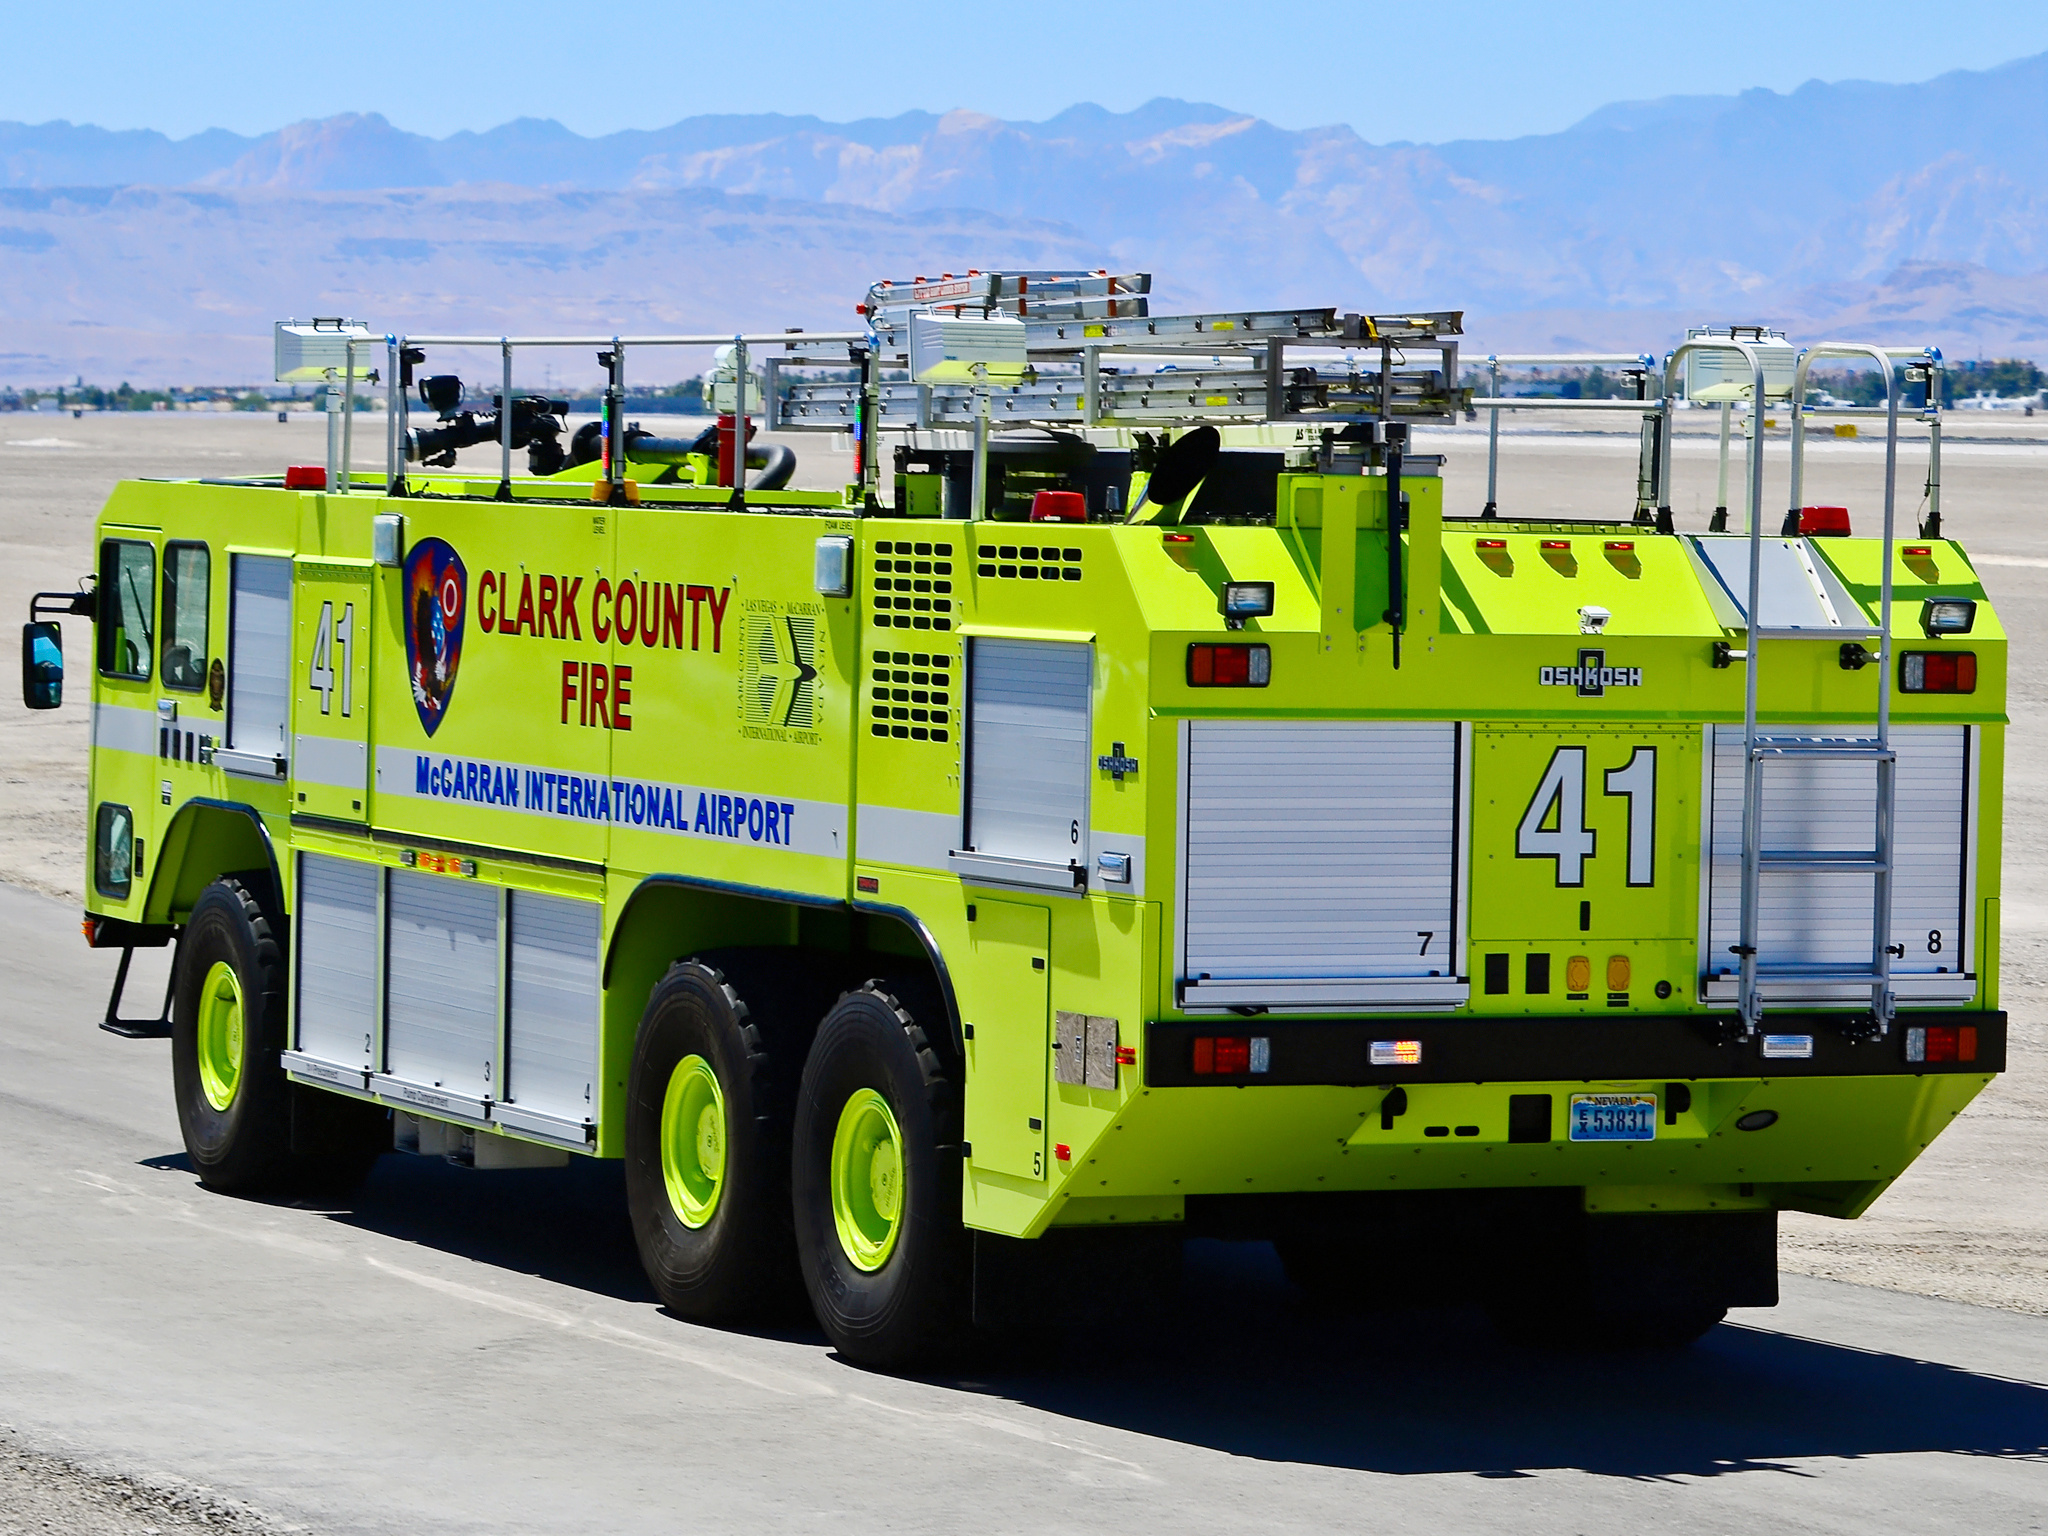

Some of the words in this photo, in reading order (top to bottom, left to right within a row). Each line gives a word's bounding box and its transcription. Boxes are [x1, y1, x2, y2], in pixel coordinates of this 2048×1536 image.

[839, 521, 853, 530] LEVEL
[478, 570, 583, 641] CLARK
[593, 578, 731, 653] COUNTY
[757, 600, 777, 613] VEGAS
[310, 601, 353, 717] 41
[1540, 667, 1642, 686] OSHKOSH
[561, 661, 632, 731] FIRE
[743, 726, 787, 742] INTERNATIONAL
[793, 731, 819, 746] AIRPORT
[525, 770, 688, 831] INTERNATIONAL
[694, 792, 794, 845] AIRPORT
[1515, 746, 1657, 888] 41
[1071, 819, 1079, 845] 6
[1417, 931, 1433, 956] 7
[1927, 929, 1942, 954] 8
[364, 1033, 371, 1053] 2
[484, 1061, 490, 1081] 3
[584, 1083, 590, 1104] 4
[1594, 1096, 1634, 1106] NEVADA
[1594, 1109, 1649, 1133] 53831
[1033, 1151, 1041, 1176] 5
